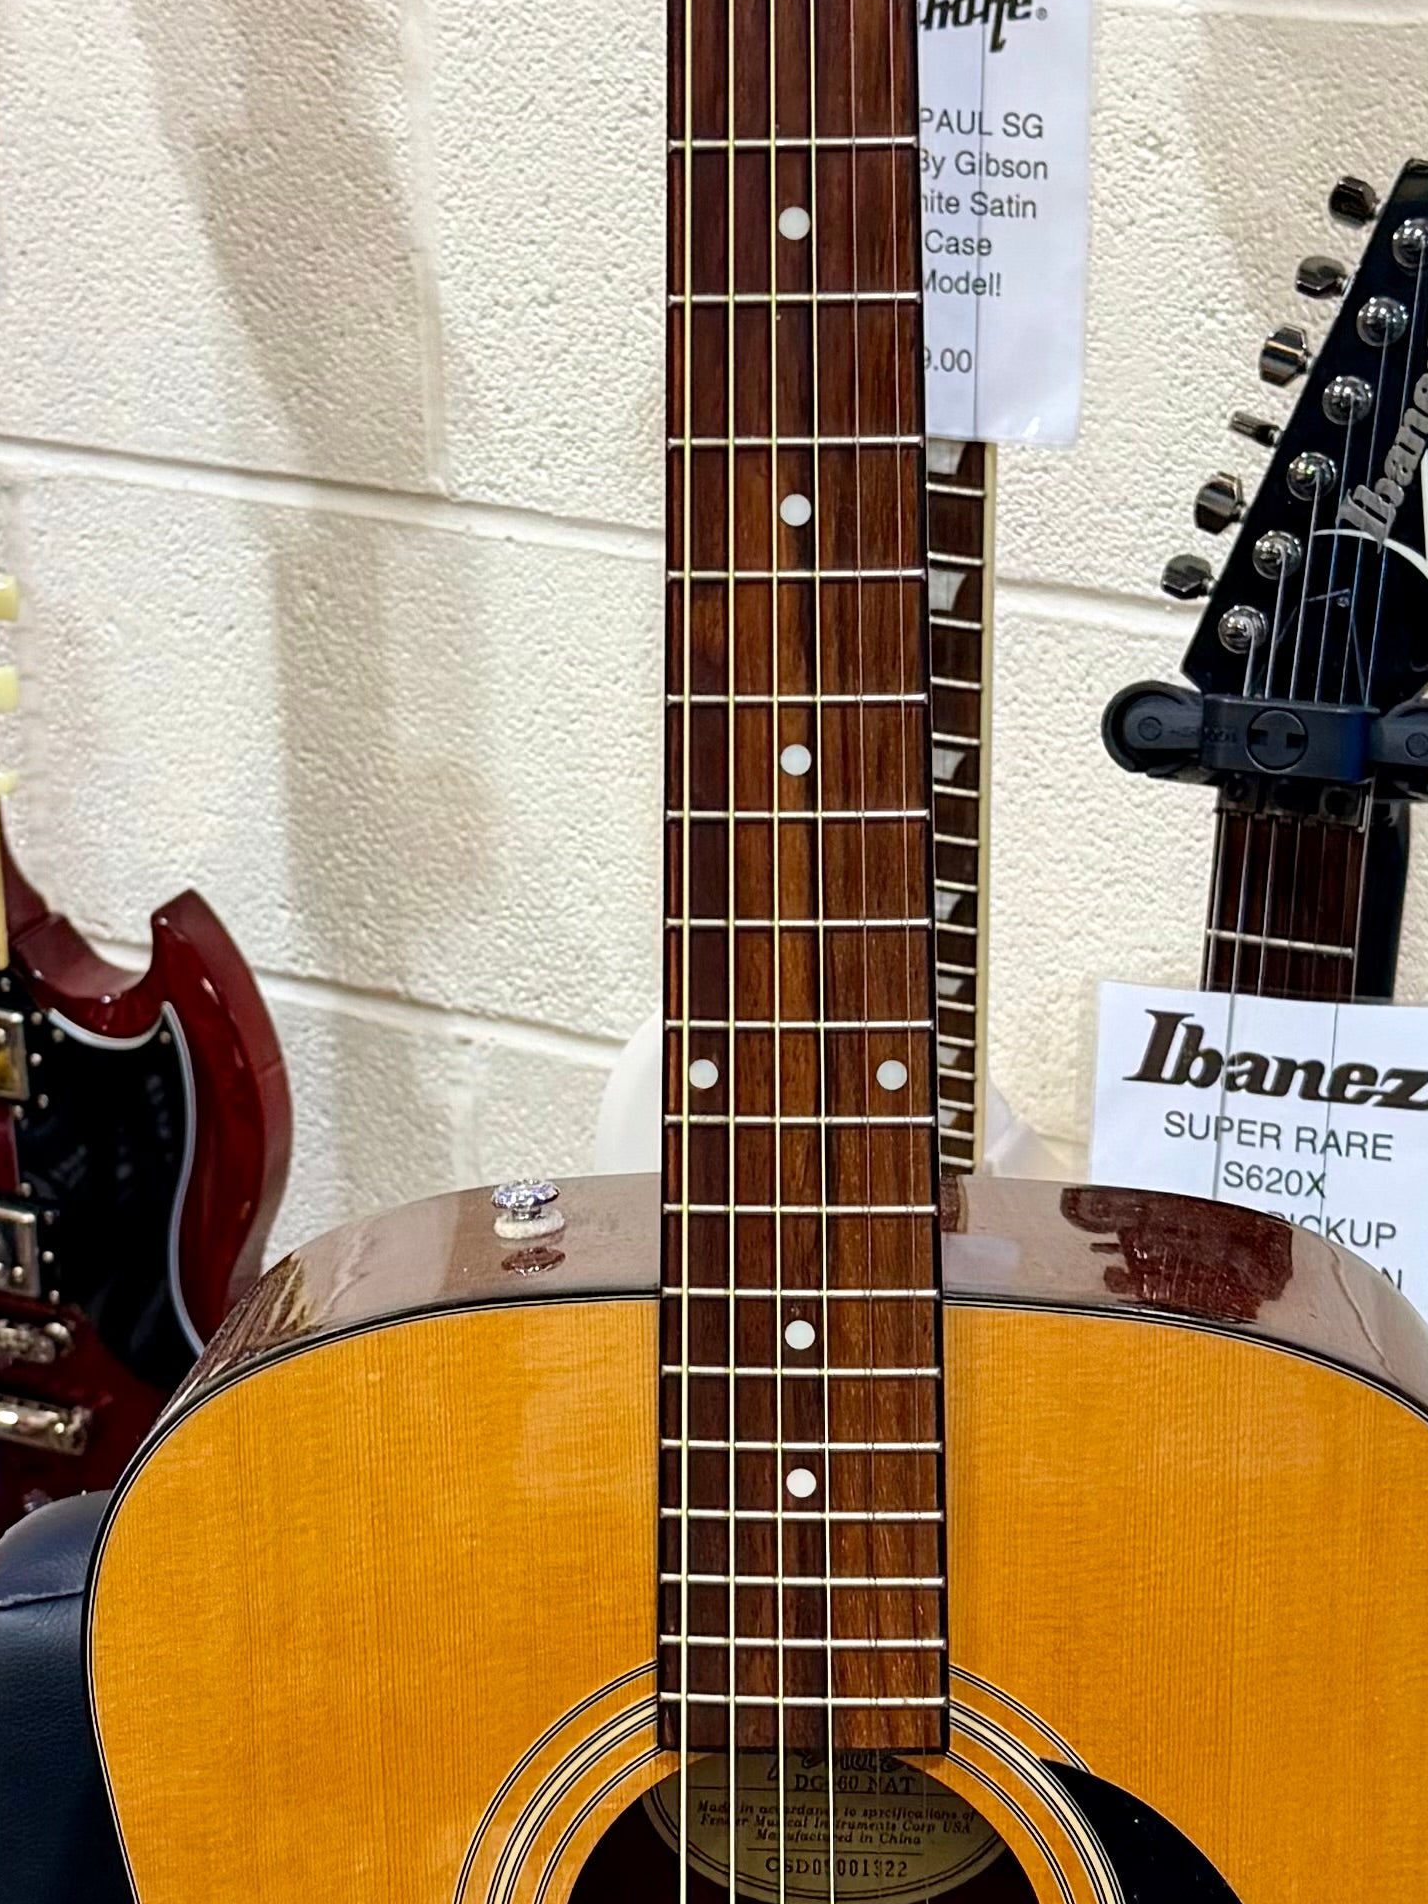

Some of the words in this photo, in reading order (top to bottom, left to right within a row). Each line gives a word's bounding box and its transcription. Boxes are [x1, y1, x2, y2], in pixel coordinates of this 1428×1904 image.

[1002, 111, 1045, 139] SG
[955, 150, 1049, 182] Gibson
[969, 190, 1038, 220] Satin
[924, 228, 993, 257] Case
[923, 348, 972, 373] 9.00
[1164, 1110, 1282, 1150] SUPER
[1295, 1125, 1394, 1162] RARE
[1223, 1159, 1327, 1200] S620X
[795, 1773, 859, 1793] DG60
[867, 1776, 917, 1794] NAT
[698, 1800, 735, 1813] Mad
[700, 1813, 748, 1826] Fener
[943, 1821, 971, 1834] USA
[880, 1831, 922, 1845] China
